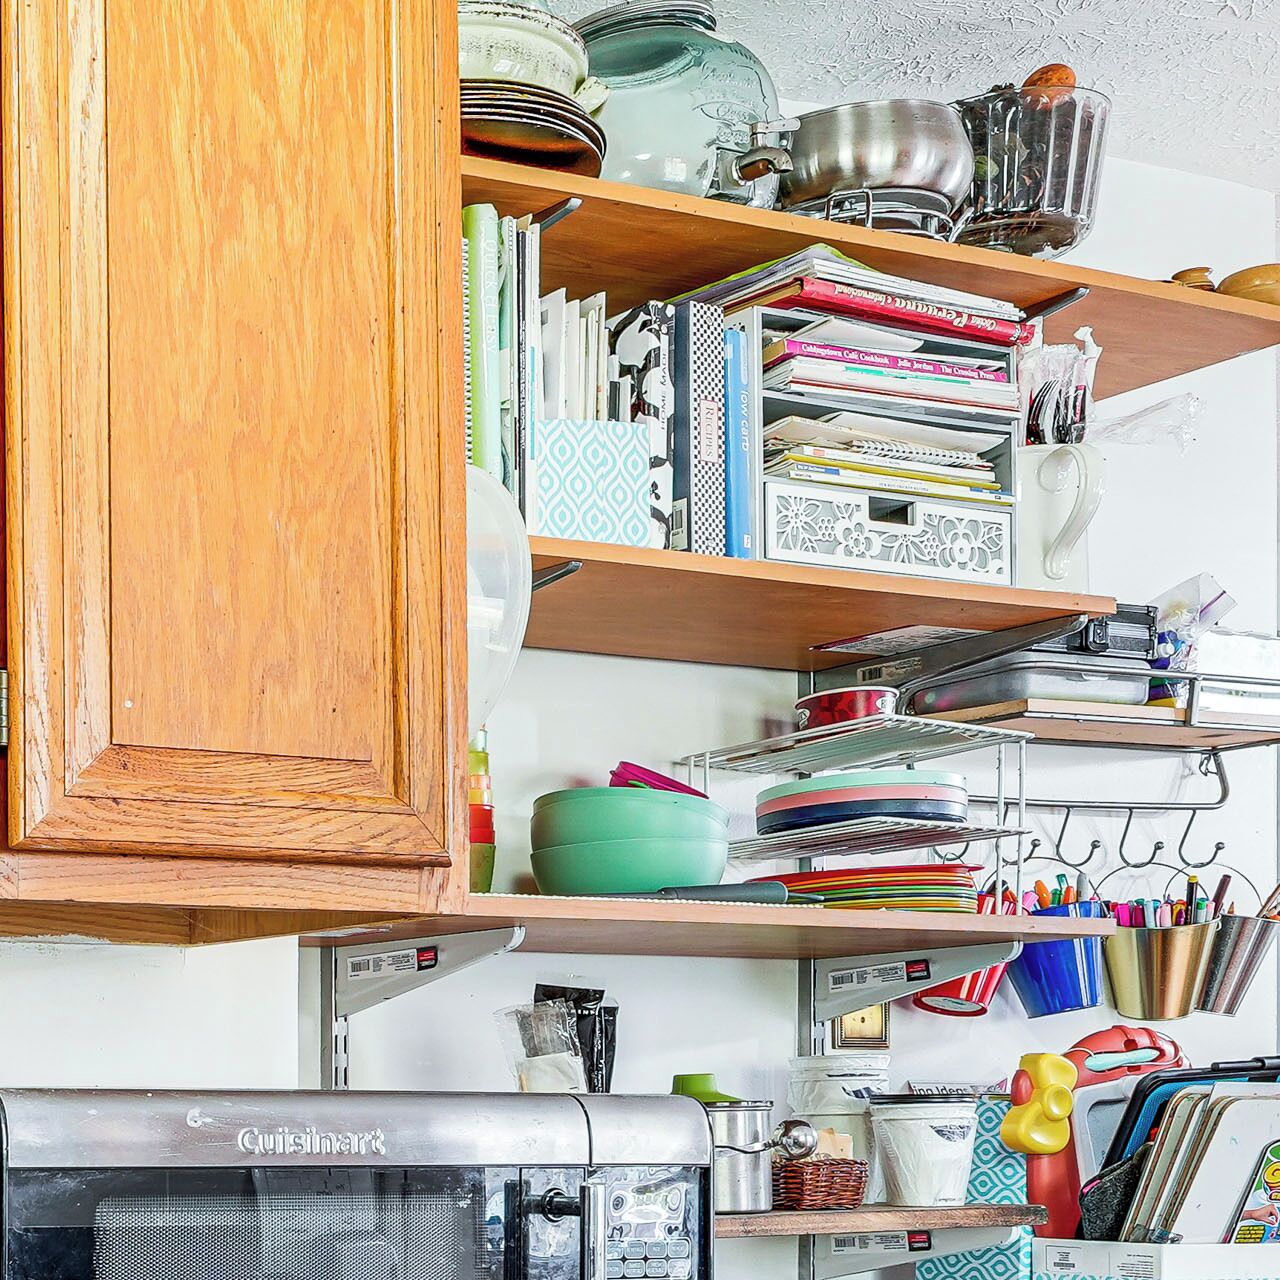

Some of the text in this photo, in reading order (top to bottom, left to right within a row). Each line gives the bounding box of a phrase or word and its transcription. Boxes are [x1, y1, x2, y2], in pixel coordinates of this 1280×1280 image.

[895, 297, 969, 328] Peruana
[741, 390, 749, 452] low carb
[237, 1127, 385, 1155] Cuisinart
